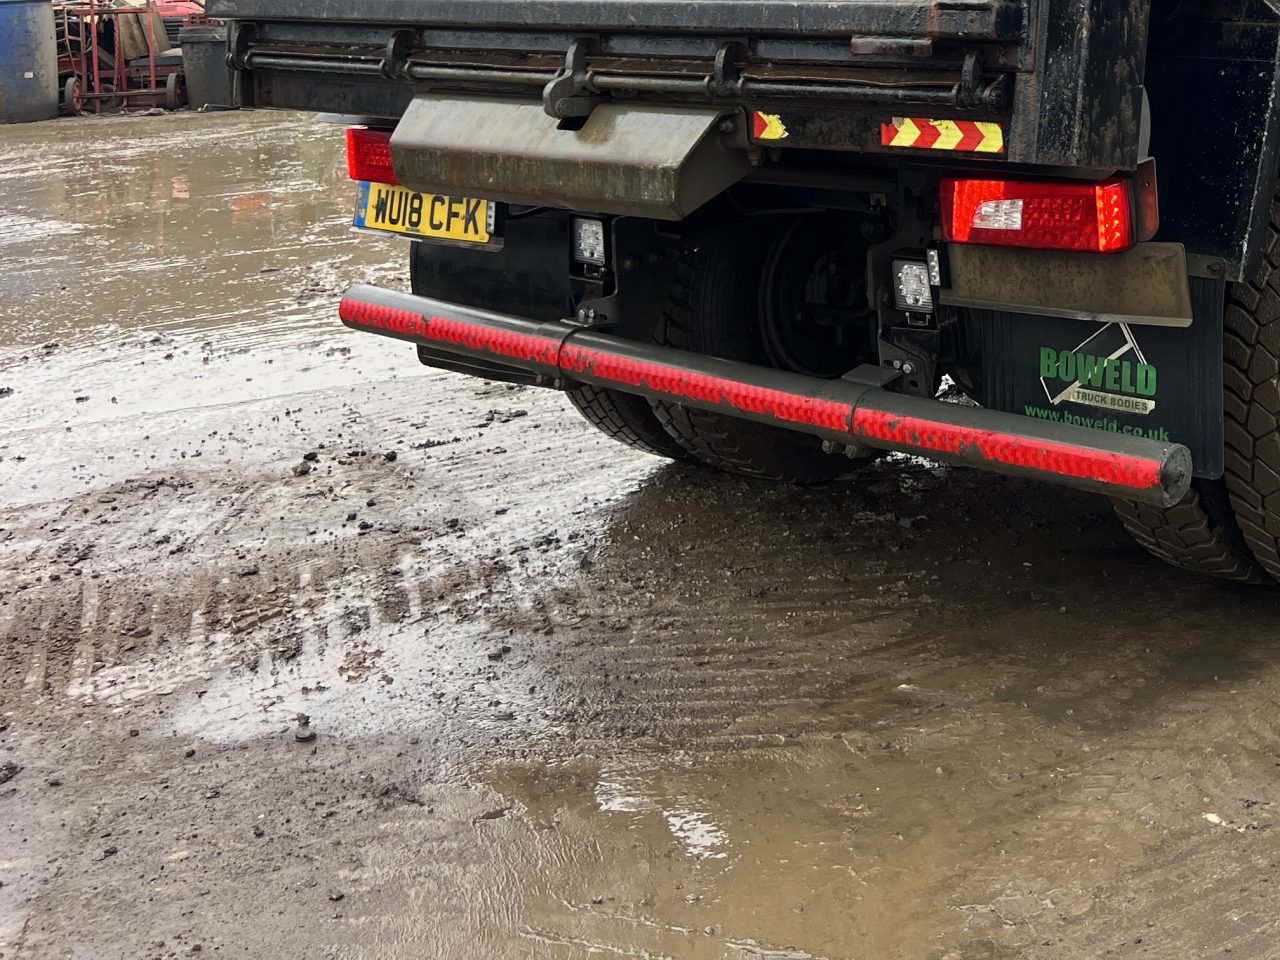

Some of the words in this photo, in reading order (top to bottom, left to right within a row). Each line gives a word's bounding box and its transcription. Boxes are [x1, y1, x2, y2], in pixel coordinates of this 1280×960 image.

[374, 188, 424, 228] WU18
[429, 194, 482, 235] CFK
[1039, 346, 1157, 396] BOWELD
[1075, 390, 1108, 406] TRUCK
[1109, 397, 1148, 411] BODIES
[1024, 405, 1170, 442] www.boweld.co.uk
